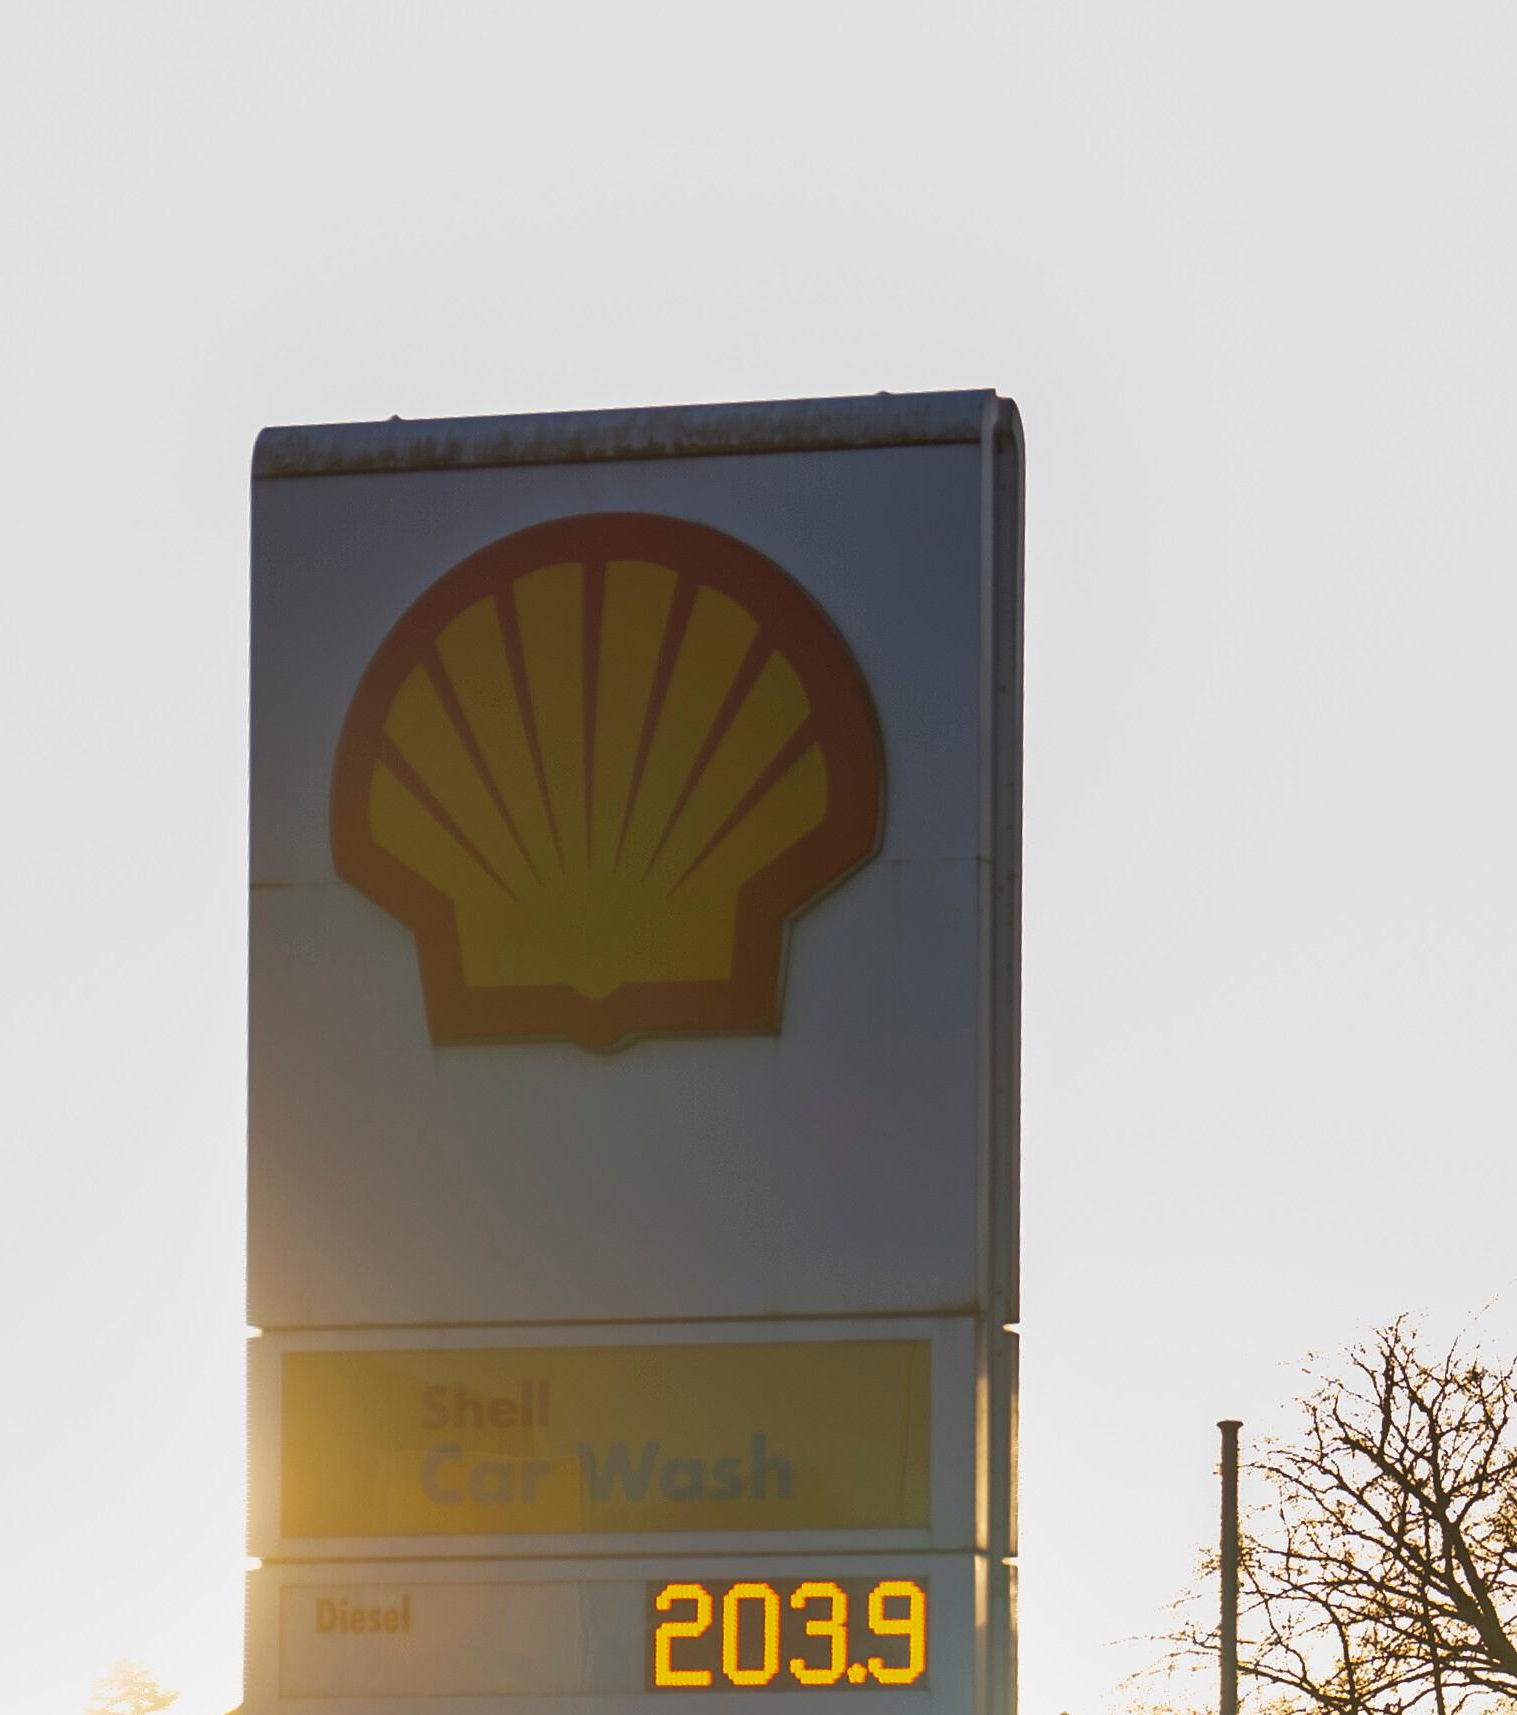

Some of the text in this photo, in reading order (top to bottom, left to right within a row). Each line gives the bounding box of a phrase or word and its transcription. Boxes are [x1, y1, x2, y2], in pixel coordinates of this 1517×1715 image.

[418, 1379, 553, 1432] Shell
[418, 1432, 796, 1506] Car Wash
[314, 1580, 928, 1688] Diesel 203.9
